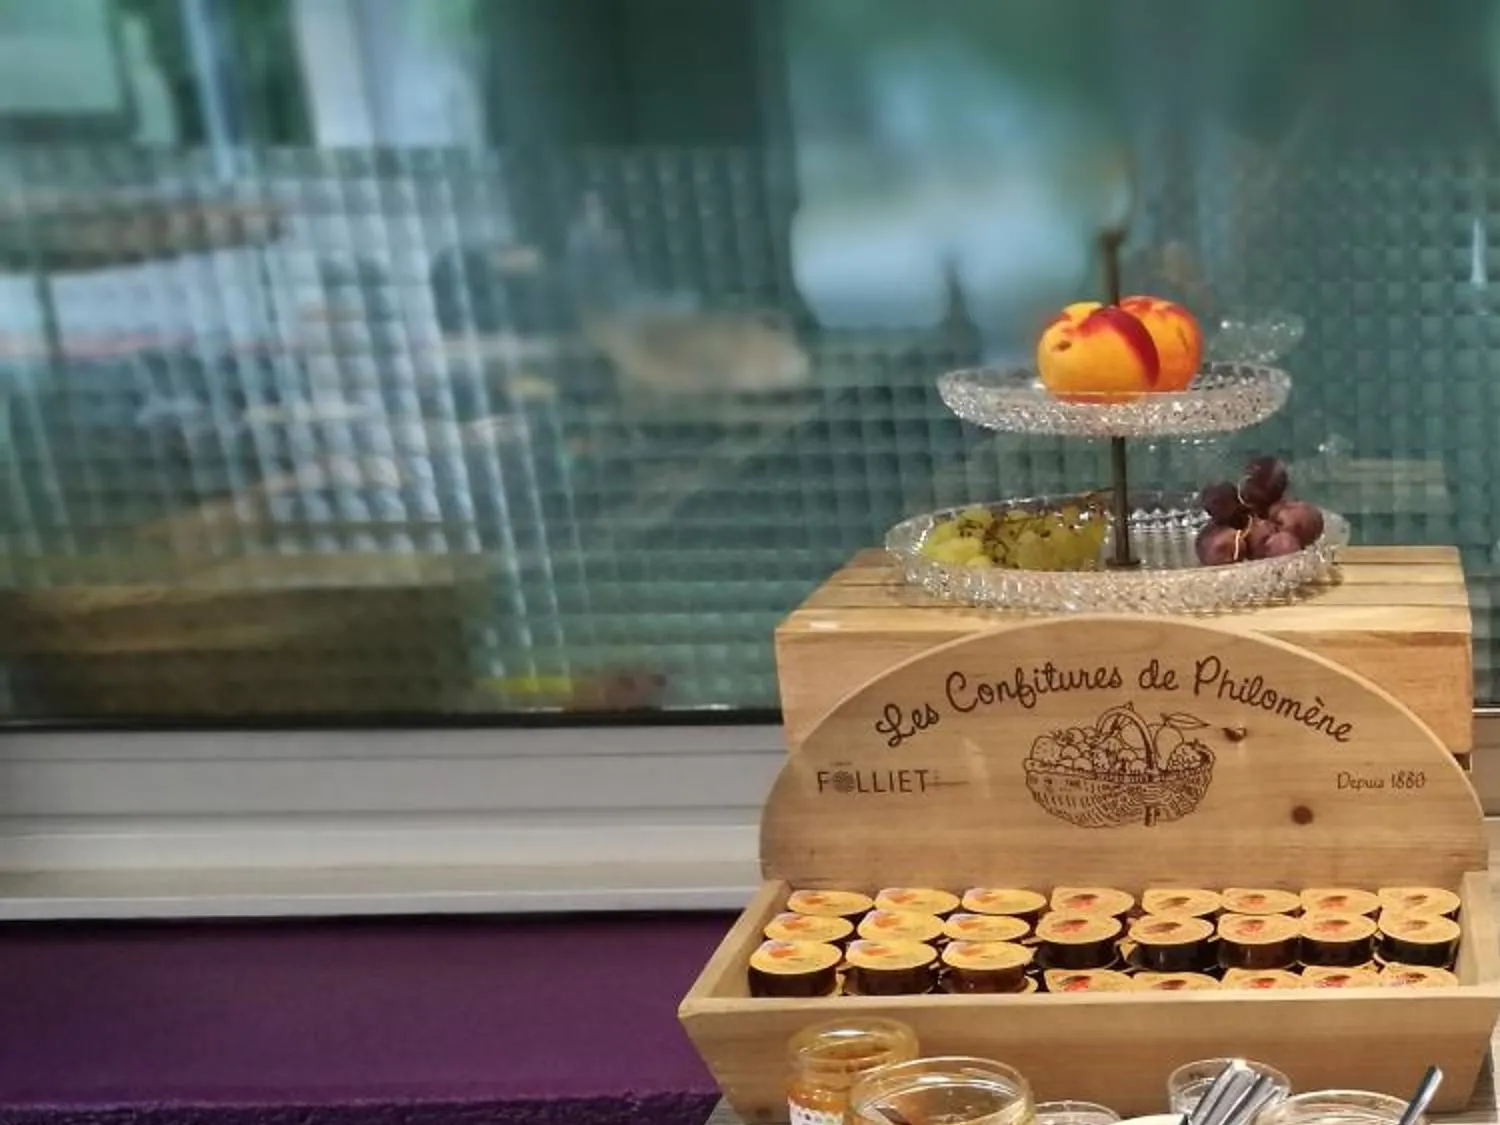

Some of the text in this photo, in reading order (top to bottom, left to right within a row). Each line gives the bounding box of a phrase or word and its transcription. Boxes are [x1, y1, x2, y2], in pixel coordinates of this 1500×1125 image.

[874, 655, 1354, 749] Les Confitures de Philomène
[816, 769, 929, 794] FOLLIET
